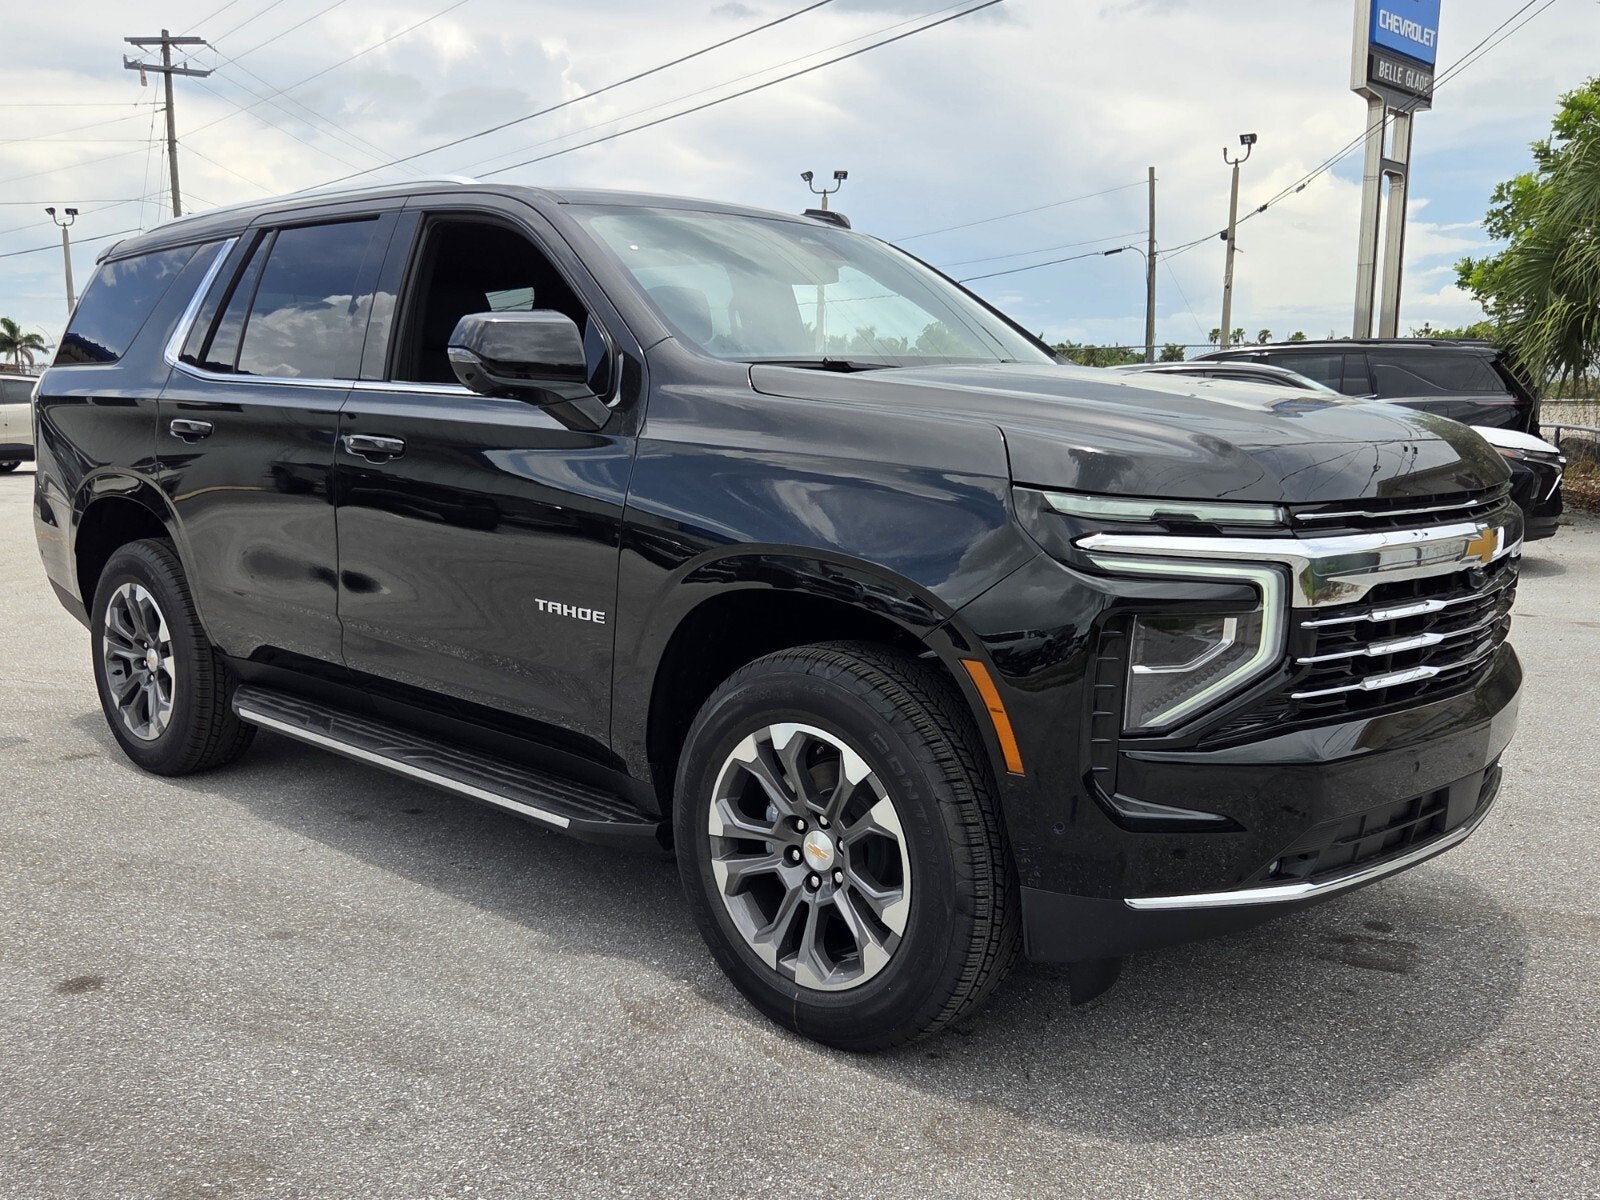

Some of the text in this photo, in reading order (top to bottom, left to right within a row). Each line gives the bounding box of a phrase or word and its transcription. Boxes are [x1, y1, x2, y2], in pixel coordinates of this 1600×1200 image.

[1379, 9, 1436, 47] CHEVROLET
[1379, 61, 1430, 92] BELLE GLADE
[534, 598, 606, 624] TAHOE
